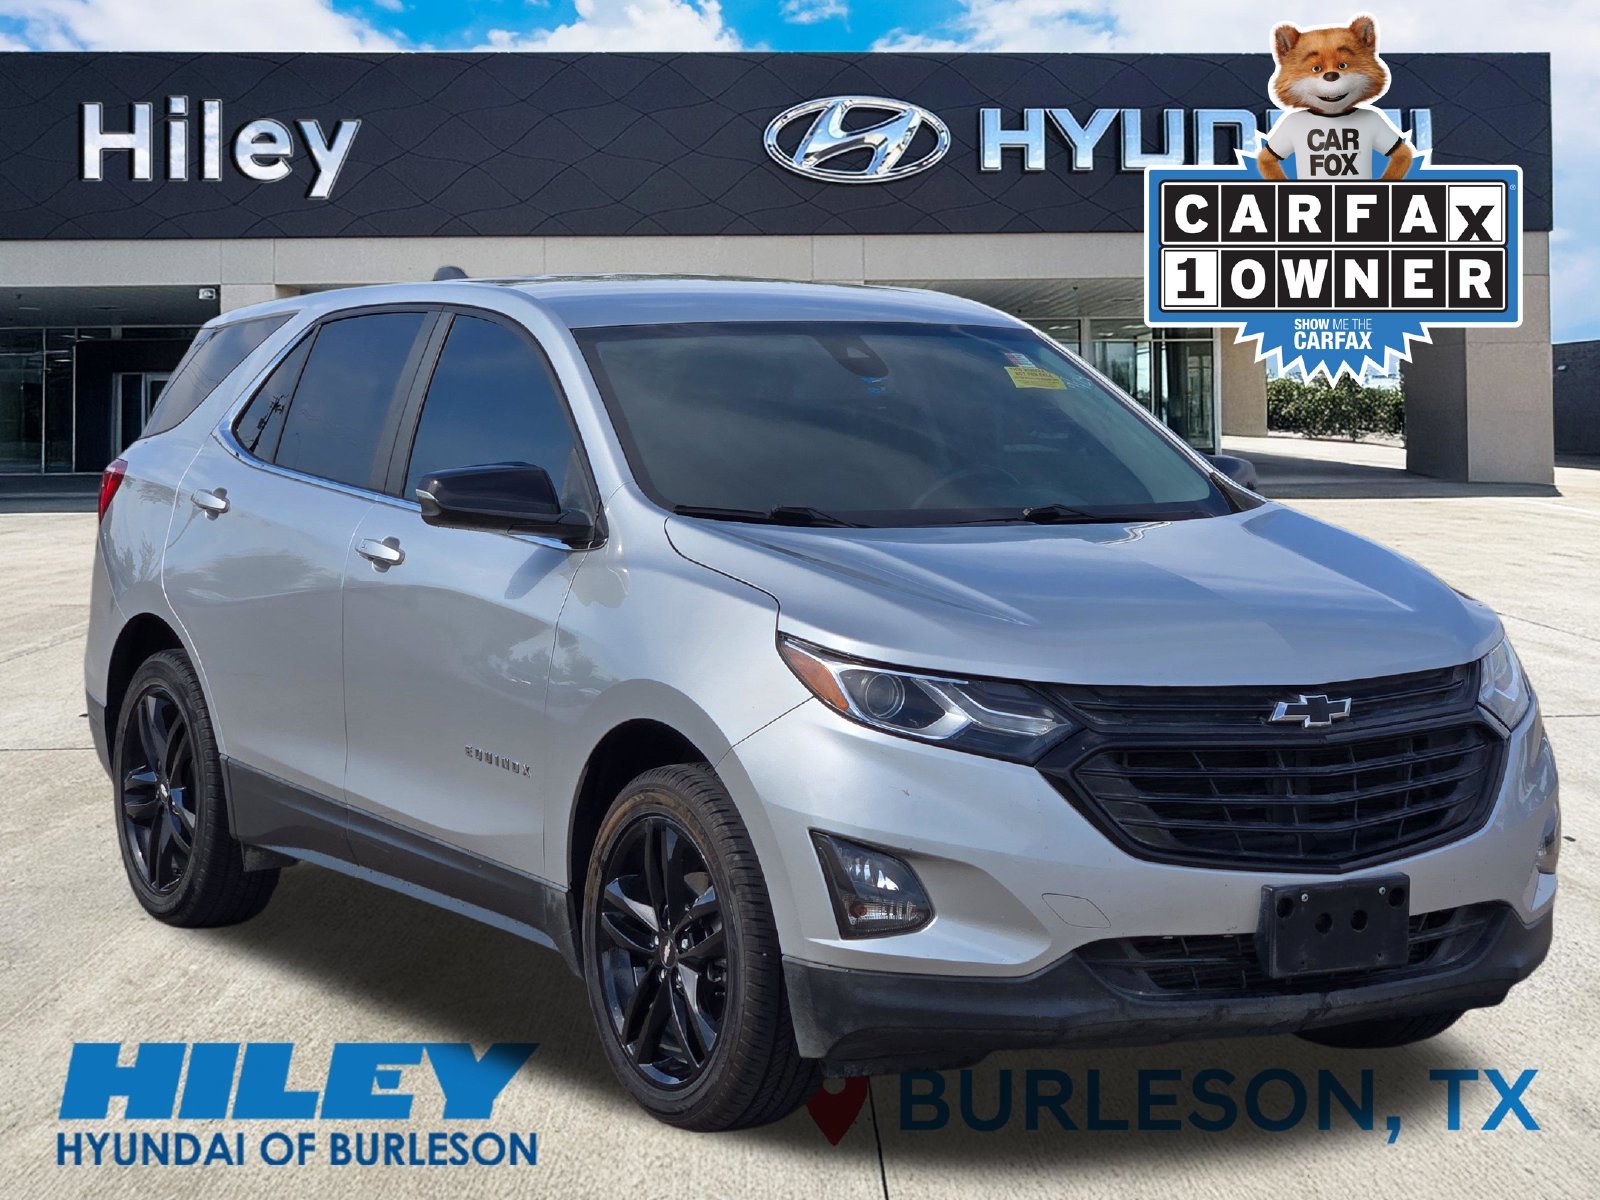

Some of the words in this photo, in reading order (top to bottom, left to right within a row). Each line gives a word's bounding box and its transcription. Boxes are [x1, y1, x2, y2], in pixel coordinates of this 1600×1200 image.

[81, 95, 362, 199] Hiley
[979, 107, 1433, 172] HYUNI
[464, 744, 532, 779] EQUINOX
